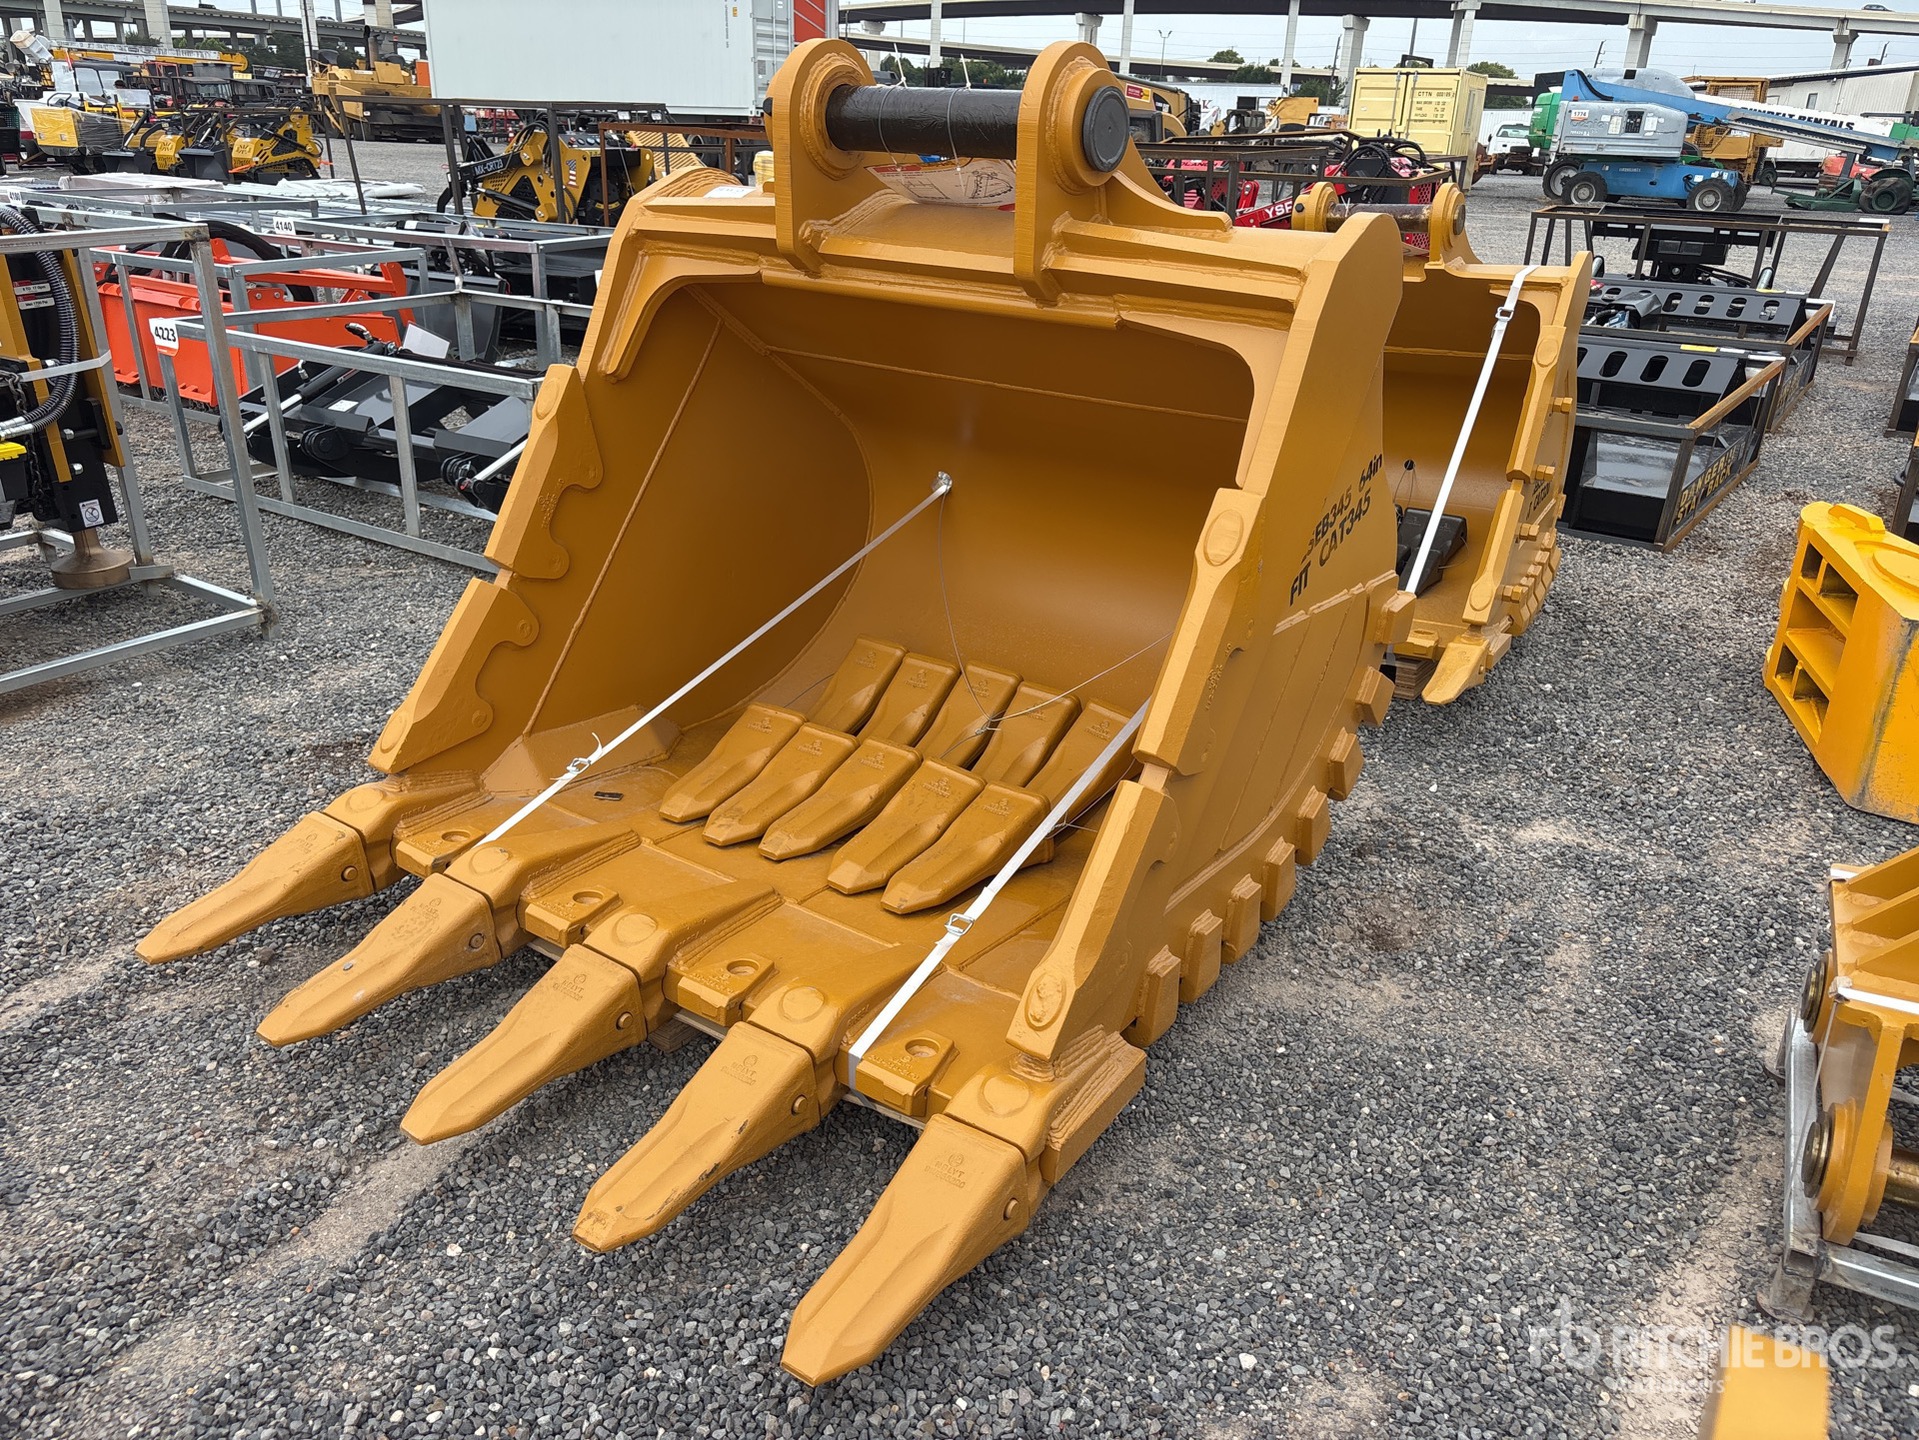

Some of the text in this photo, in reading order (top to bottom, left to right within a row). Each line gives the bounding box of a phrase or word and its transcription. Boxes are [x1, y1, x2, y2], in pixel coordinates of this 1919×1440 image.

[275, 220, 293, 232] 4140
[154, 326, 177, 343] 4223
[1338, 453, 1383, 493] 64in
[1706, 463, 1734, 498] BACK
[1289, 487, 1371, 607] FIT CAT345
